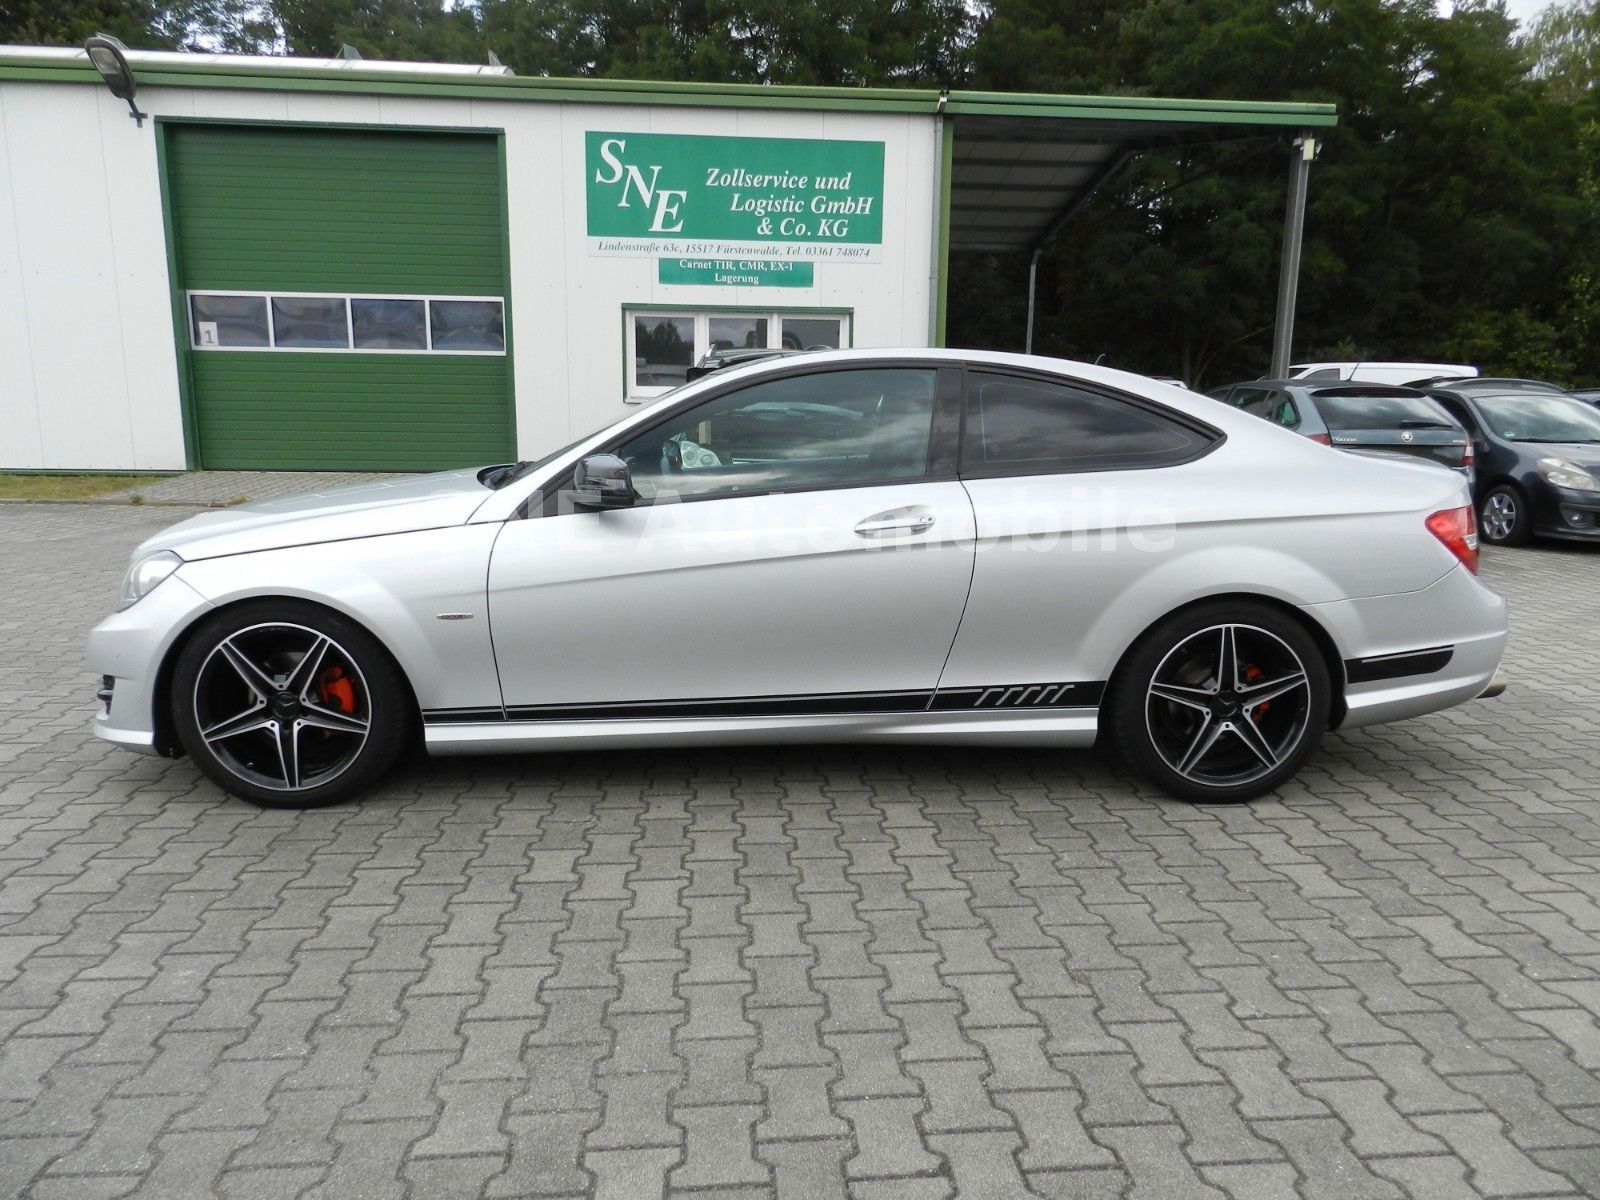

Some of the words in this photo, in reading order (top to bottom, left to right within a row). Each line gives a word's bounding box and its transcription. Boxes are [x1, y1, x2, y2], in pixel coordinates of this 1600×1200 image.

[595, 139, 688, 233] SNE
[705, 167, 808, 189] Zollservice
[814, 171, 852, 190] und
[730, 193, 805, 217] Logistic
[810, 195, 874, 215] GmbH
[756, 217, 774, 236] &
[779, 217, 812, 236] Co.
[817, 218, 849, 237] KG
[598, 241, 661, 254] Lindenstraße
[685, 243, 714, 254] 15517
[805, 246, 834, 257] 03361
[836, 247, 871, 258] 748074
[679, 259, 712, 269] Carnet
[713, 260, 737, 271] TIR,
[739, 261, 769, 272] CMR,
[714, 272, 760, 285] Lagerung
[204, 329, 215, 344] 1
